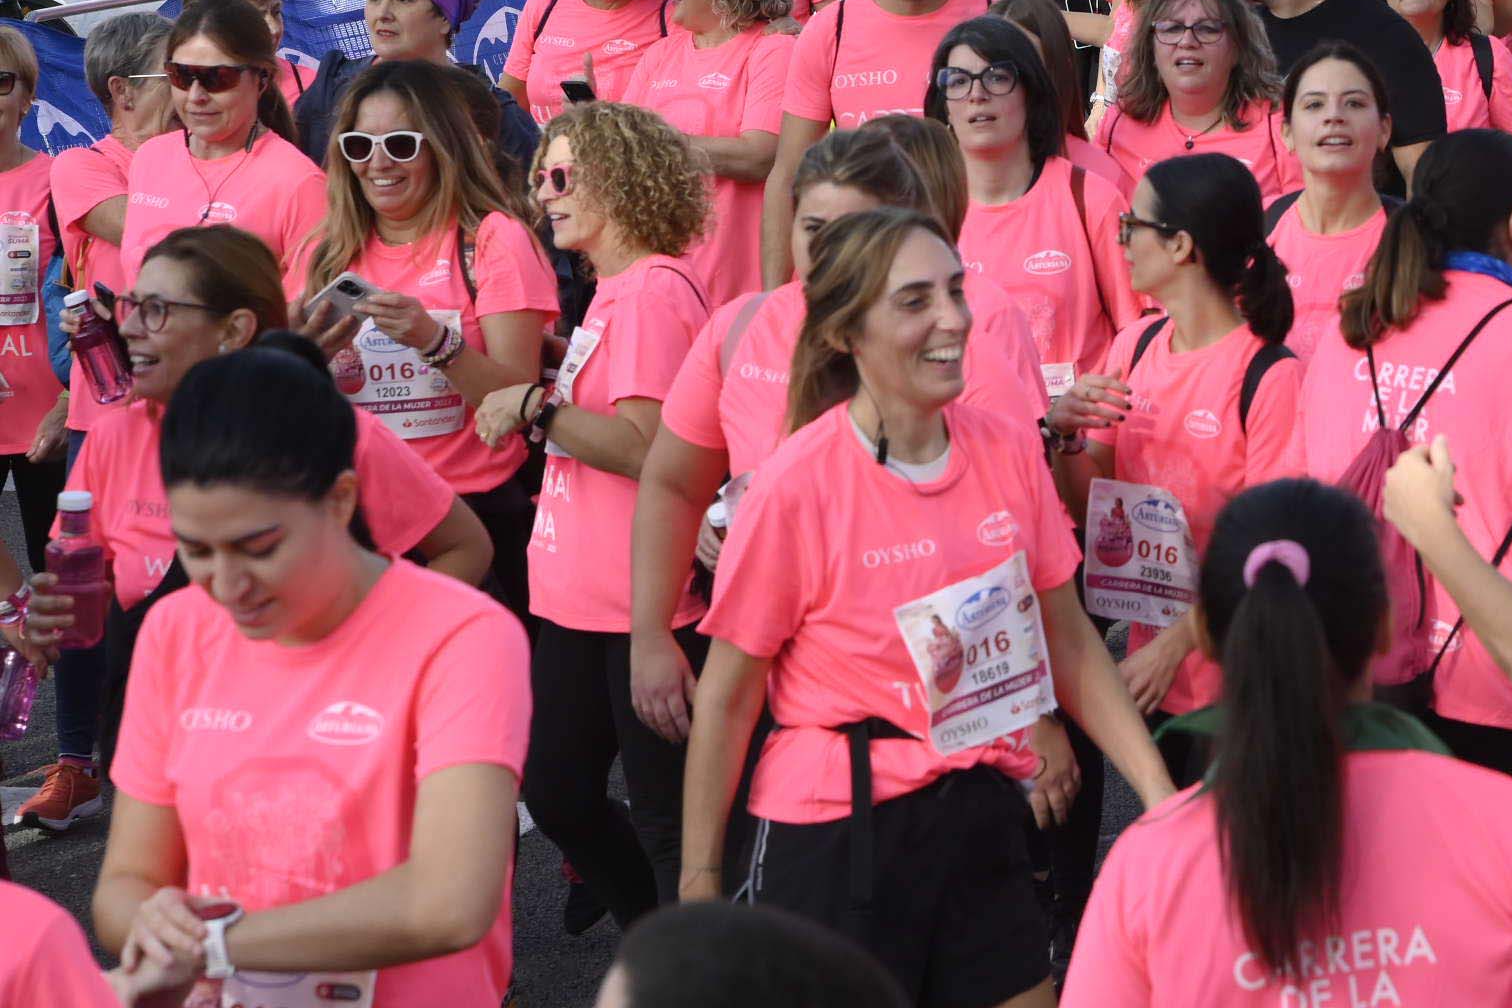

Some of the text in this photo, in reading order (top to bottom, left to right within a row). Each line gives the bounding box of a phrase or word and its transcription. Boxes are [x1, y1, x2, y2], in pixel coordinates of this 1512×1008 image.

[834, 69, 898, 89] OYSHO
[370, 362, 415, 382] 016
[376, 385, 411, 399] 12023
[863, 539, 936, 570] OYSHO
[1138, 539, 1178, 564] 016
[1140, 565, 1172, 582] 23936
[1096, 597, 1141, 612] OYSHO
[967, 630, 1011, 666] 016
[972, 661, 1010, 685] 18619
